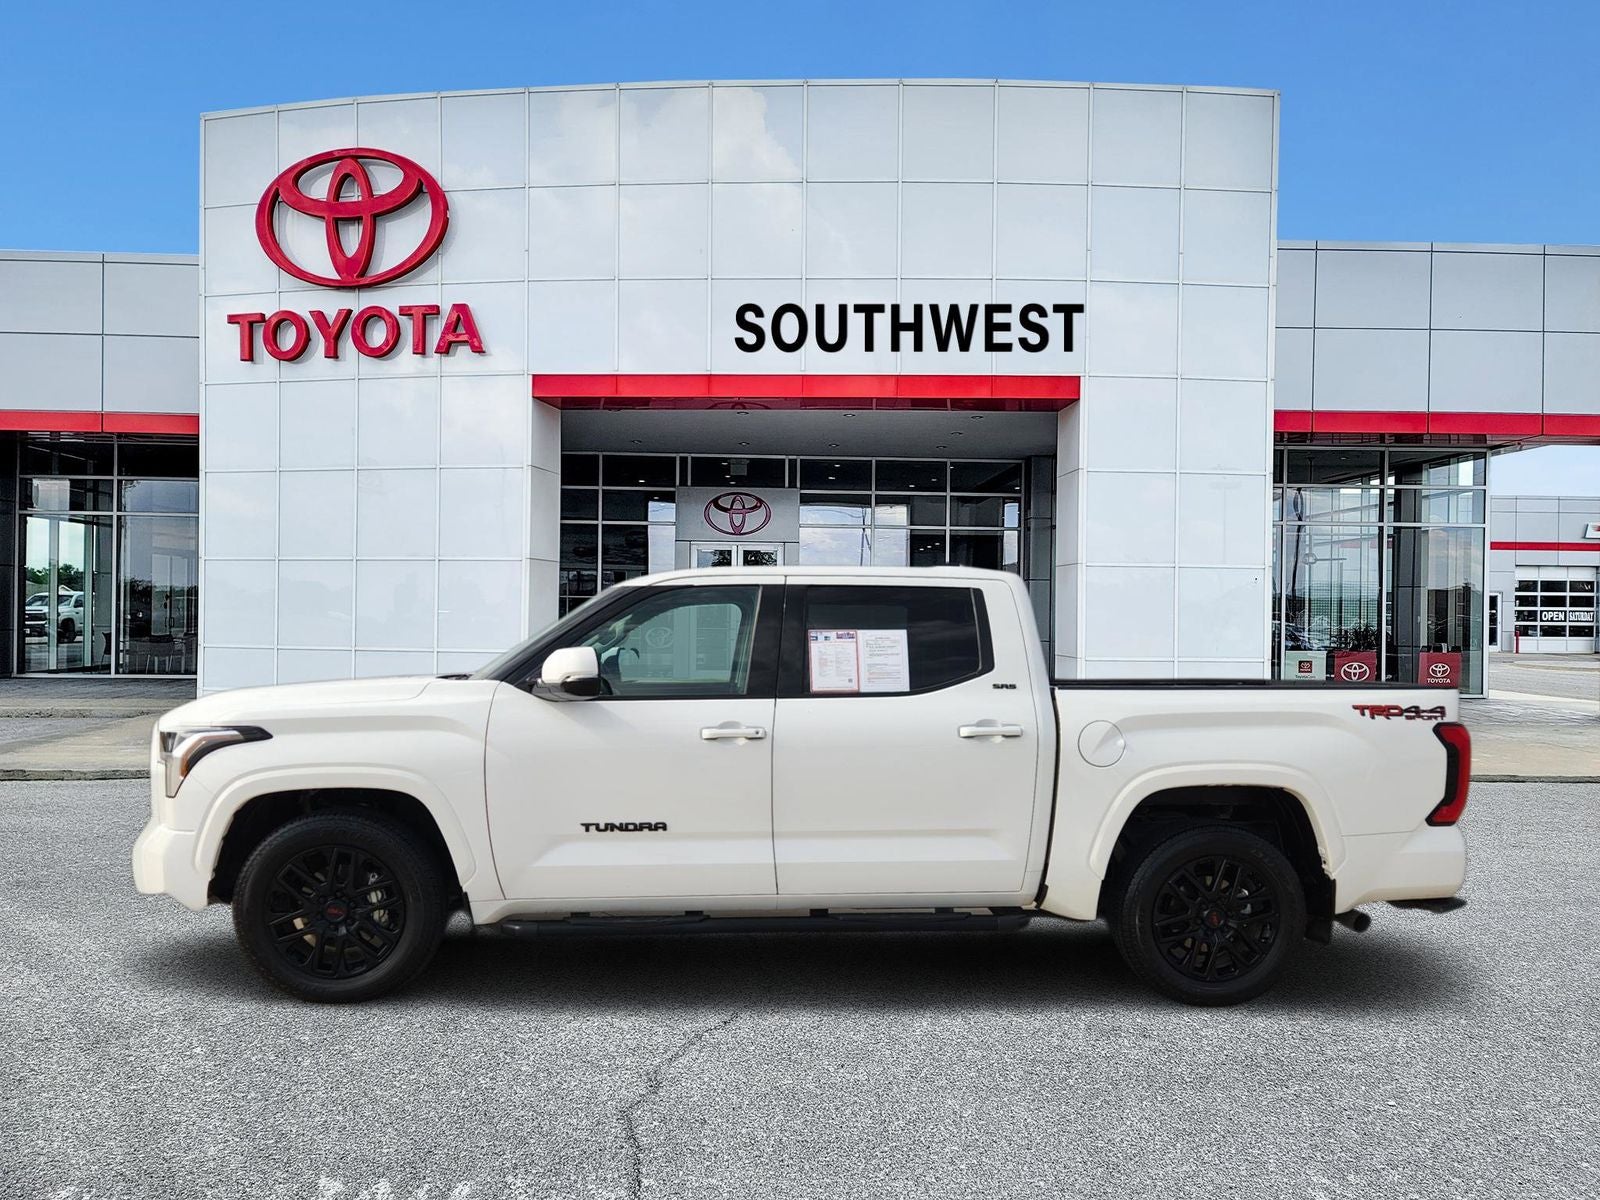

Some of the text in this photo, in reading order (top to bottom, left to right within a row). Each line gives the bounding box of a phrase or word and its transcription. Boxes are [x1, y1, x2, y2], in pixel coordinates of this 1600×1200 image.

[227, 303, 486, 362] TOYOTA
[734, 303, 1084, 353] SOUTHWEST
[1541, 611, 1594, 621] OPEN SATURDAY
[1352, 704, 1404, 720] TRD
[580, 822, 668, 833] TUNDRA
